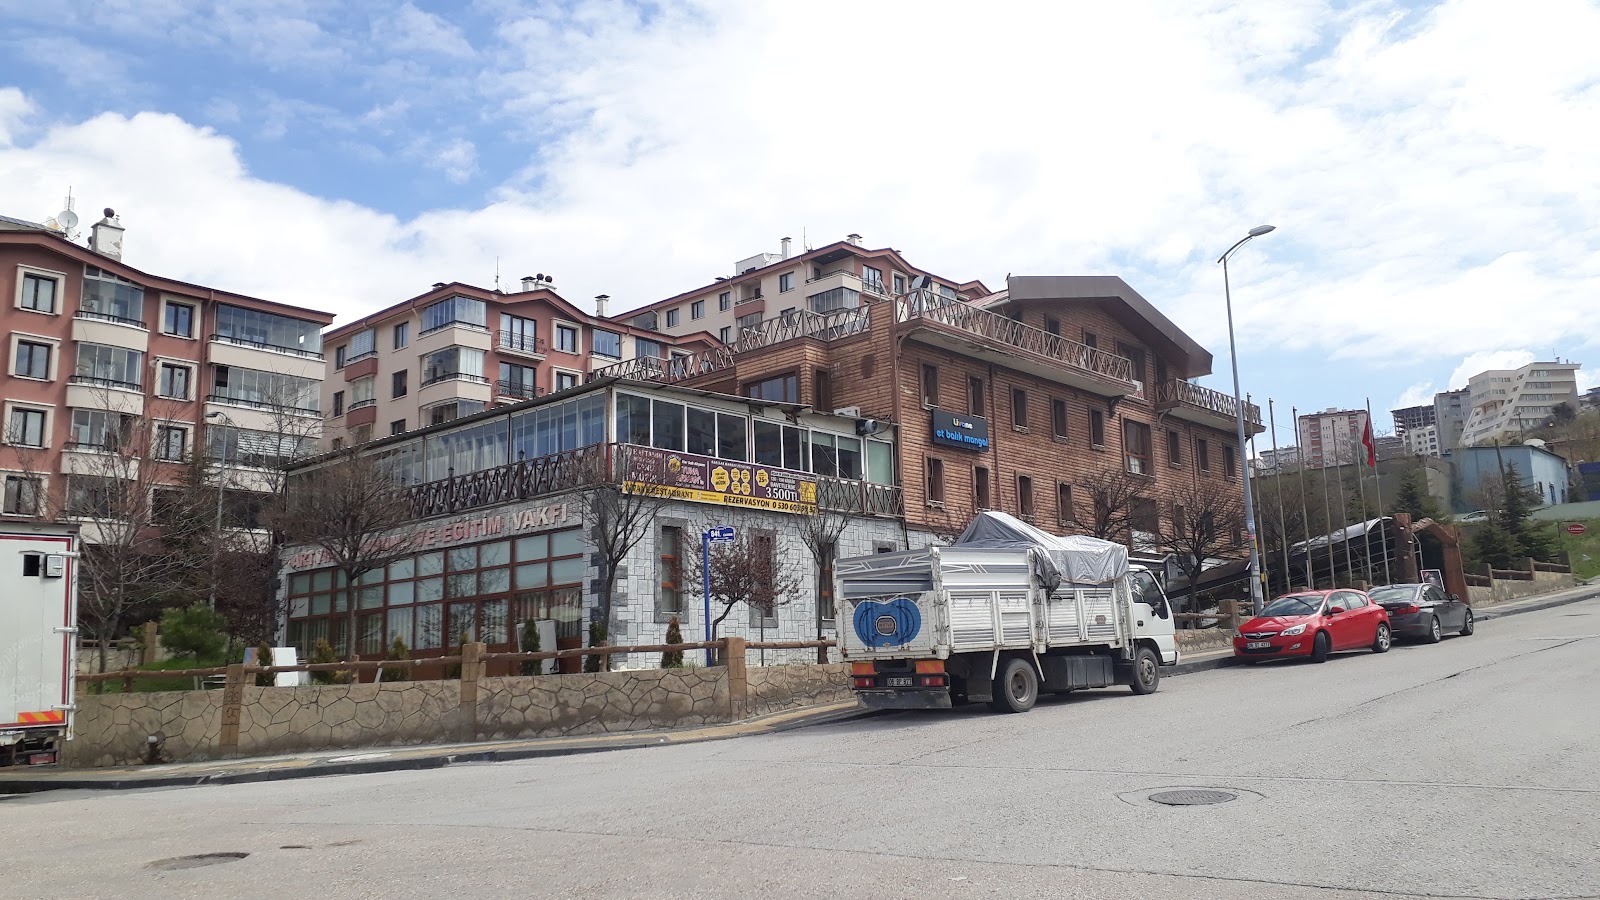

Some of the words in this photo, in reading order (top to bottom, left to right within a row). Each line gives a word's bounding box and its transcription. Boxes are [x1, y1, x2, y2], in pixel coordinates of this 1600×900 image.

[937, 430, 944, 438] et
[965, 435, 989, 448] mangal
[723, 495, 770, 508] REZERVASYON
[778, 502, 788, 511] 530
[442, 513, 502, 543] EĞİTİM
[513, 503, 567, 531] VAKFI
